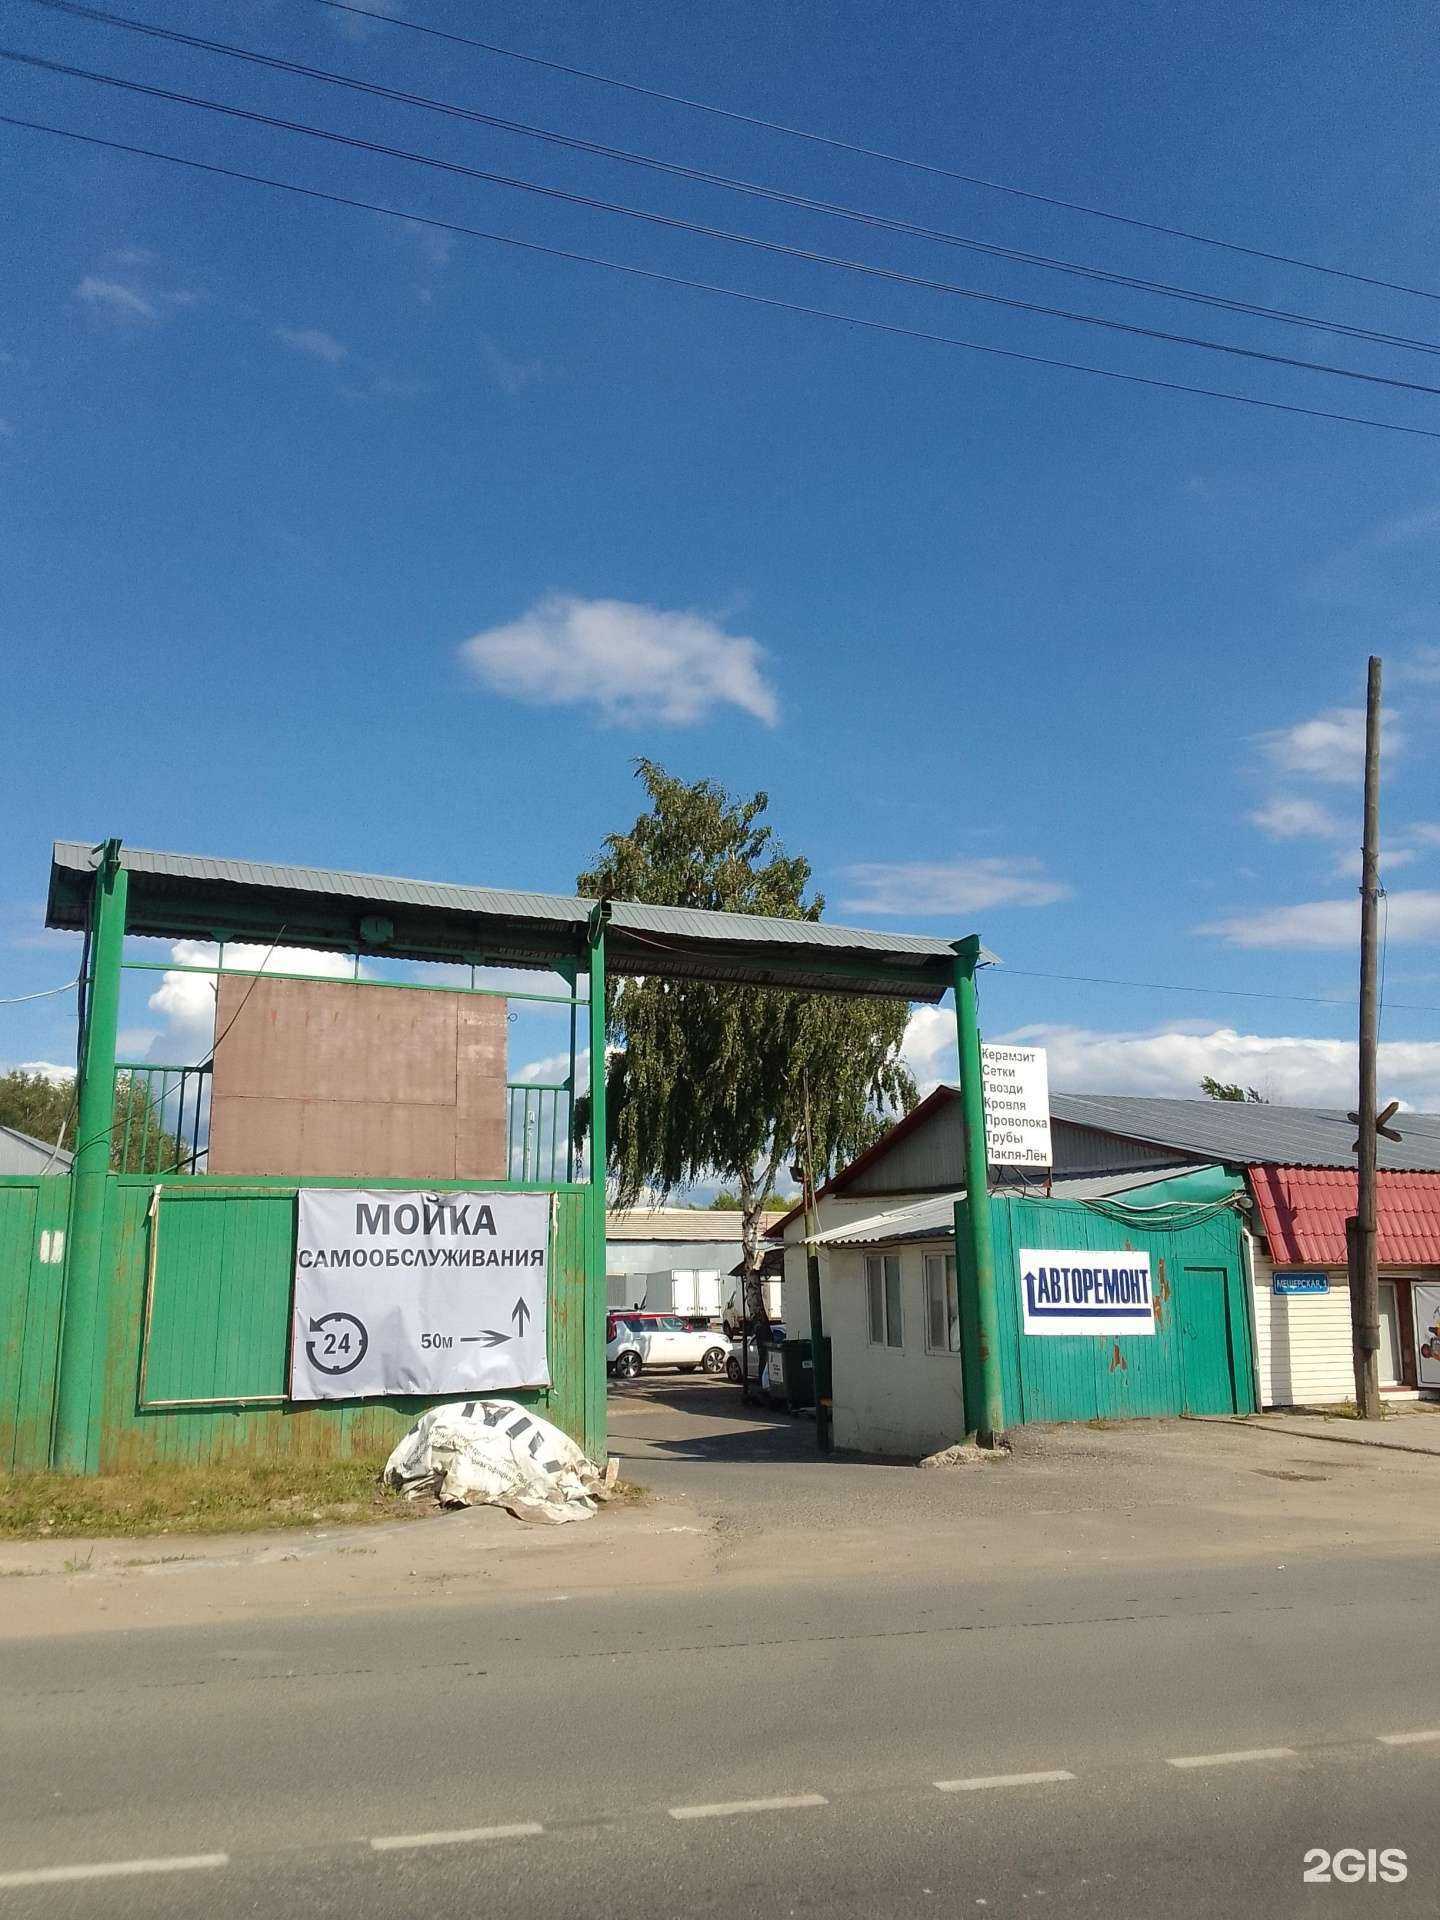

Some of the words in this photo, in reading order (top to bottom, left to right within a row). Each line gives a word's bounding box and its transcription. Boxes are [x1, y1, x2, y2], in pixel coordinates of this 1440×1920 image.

[982, 1048, 1035, 1062] Керамзит
[983, 1065, 1015, 1077] Сетки
[984, 1081, 1023, 1095] Гвозди
[985, 1097, 1026, 1111] Кровля
[985, 1114, 1048, 1128] Проволока
[986, 1131, 1023, 1145] Трубы
[356, 1196, 497, 1235] МОЙКА
[299, 1249, 544, 1268] САМООБСЛУЖИВАНИЯ
[1038, 1268, 1148, 1304] АВТОРЕМОНТ
[323, 1333, 351, 1355] 24
